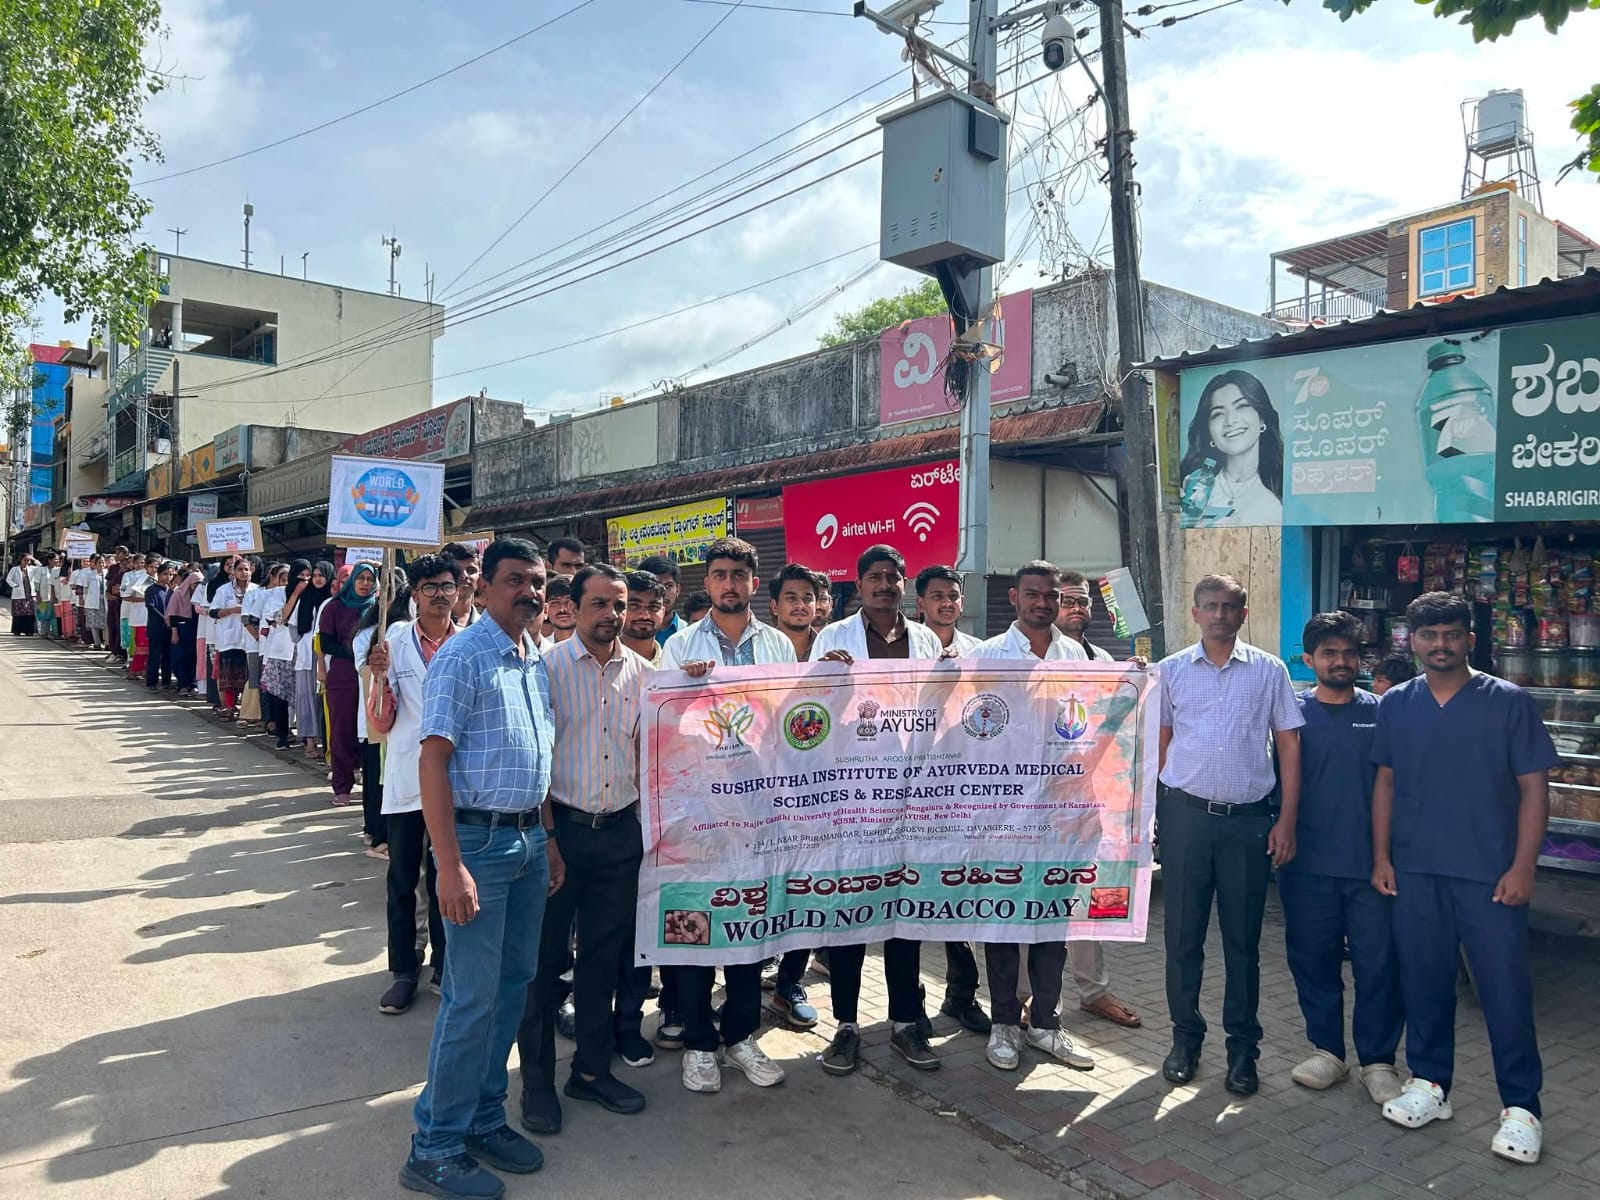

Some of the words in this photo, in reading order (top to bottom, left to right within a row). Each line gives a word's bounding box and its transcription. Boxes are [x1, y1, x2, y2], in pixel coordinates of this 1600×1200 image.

[369, 475, 405, 489] WORLD
[842, 521, 867, 537] airtel
[868, 519, 896, 534] Wi-Fi
[880, 709, 924, 718] MINISTRY
[925, 708, 937, 717] OF
[879, 717, 937, 733] AYUSH
[835, 756, 879, 764] SUSHRUTHA
[883, 755, 912, 763] AROGYA
[711, 773, 809, 794] SUSHRUTHA
[812, 767, 898, 784] INSTITUTE
[903, 766, 923, 779] OF
[927, 763, 1010, 778] AYURVEDA
[1015, 763, 1085, 776] MEDICAL
[773, 788, 849, 808] SCIENCES
[854, 788, 867, 801] &
[871, 784, 955, 801] RESEARCH
[960, 784, 1025, 797] CENTER
[692, 820, 729, 832] Affiliated
[731, 820, 741, 828] to
[743, 819, 764, 829] Rajiv
[765, 813, 791, 825] Gandhi
[793, 811, 832, 822] University
[945, 803, 952, 811] &
[953, 802, 997, 811] Recognized
[999, 802, 1008, 811] by
[1010, 801, 1057, 810] Government
[1059, 801, 1067, 809] of
[1068, 801, 1106, 809] Karnataka
[860, 816, 893, 824] Ministry
[934, 812, 949, 820] New
[950, 811, 972, 819] Delhi
[709, 880, 769, 916] ವಿಶ್ವ
[785, 863, 920, 895] ತಂಬಾಕು
[941, 863, 1024, 887] ರಹಿತ
[1043, 862, 1099, 886] ದಿನ
[722, 908, 827, 943] WORLD
[833, 905, 874, 928] NO
[881, 897, 1016, 920] TOBACCO
[1023, 898, 1080, 920] DAY
